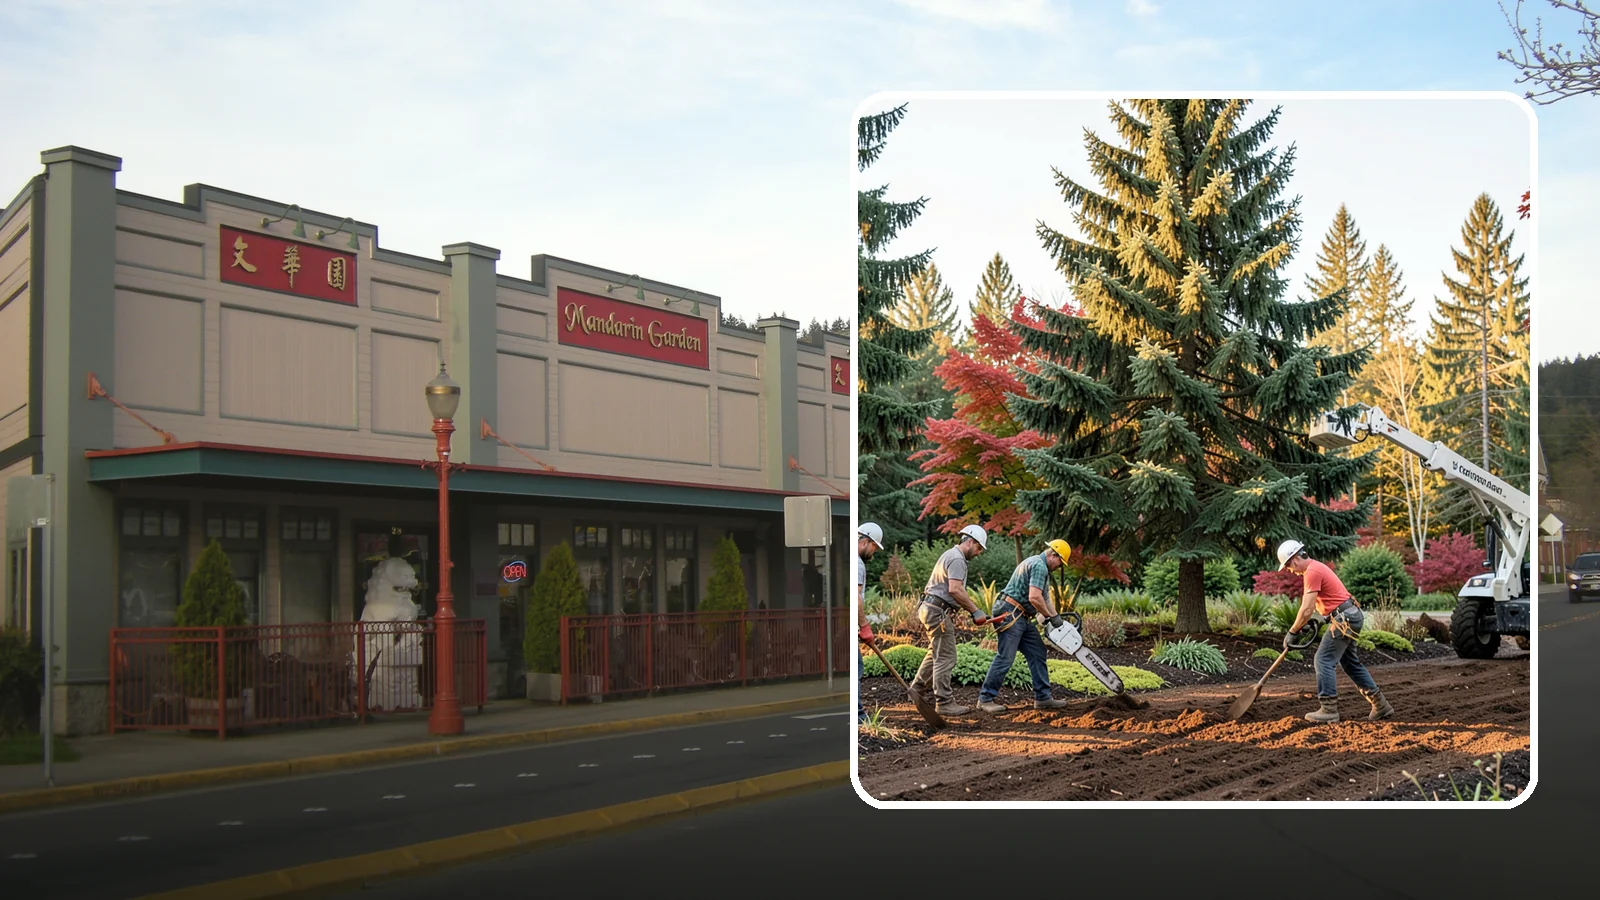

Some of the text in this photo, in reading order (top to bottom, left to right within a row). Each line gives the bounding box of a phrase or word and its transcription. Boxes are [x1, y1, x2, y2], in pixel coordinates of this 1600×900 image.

[231, 235, 346, 291] 文華園
[564, 302, 701, 352] Mandarin Garden
[503, 565, 527, 578] OPEN
